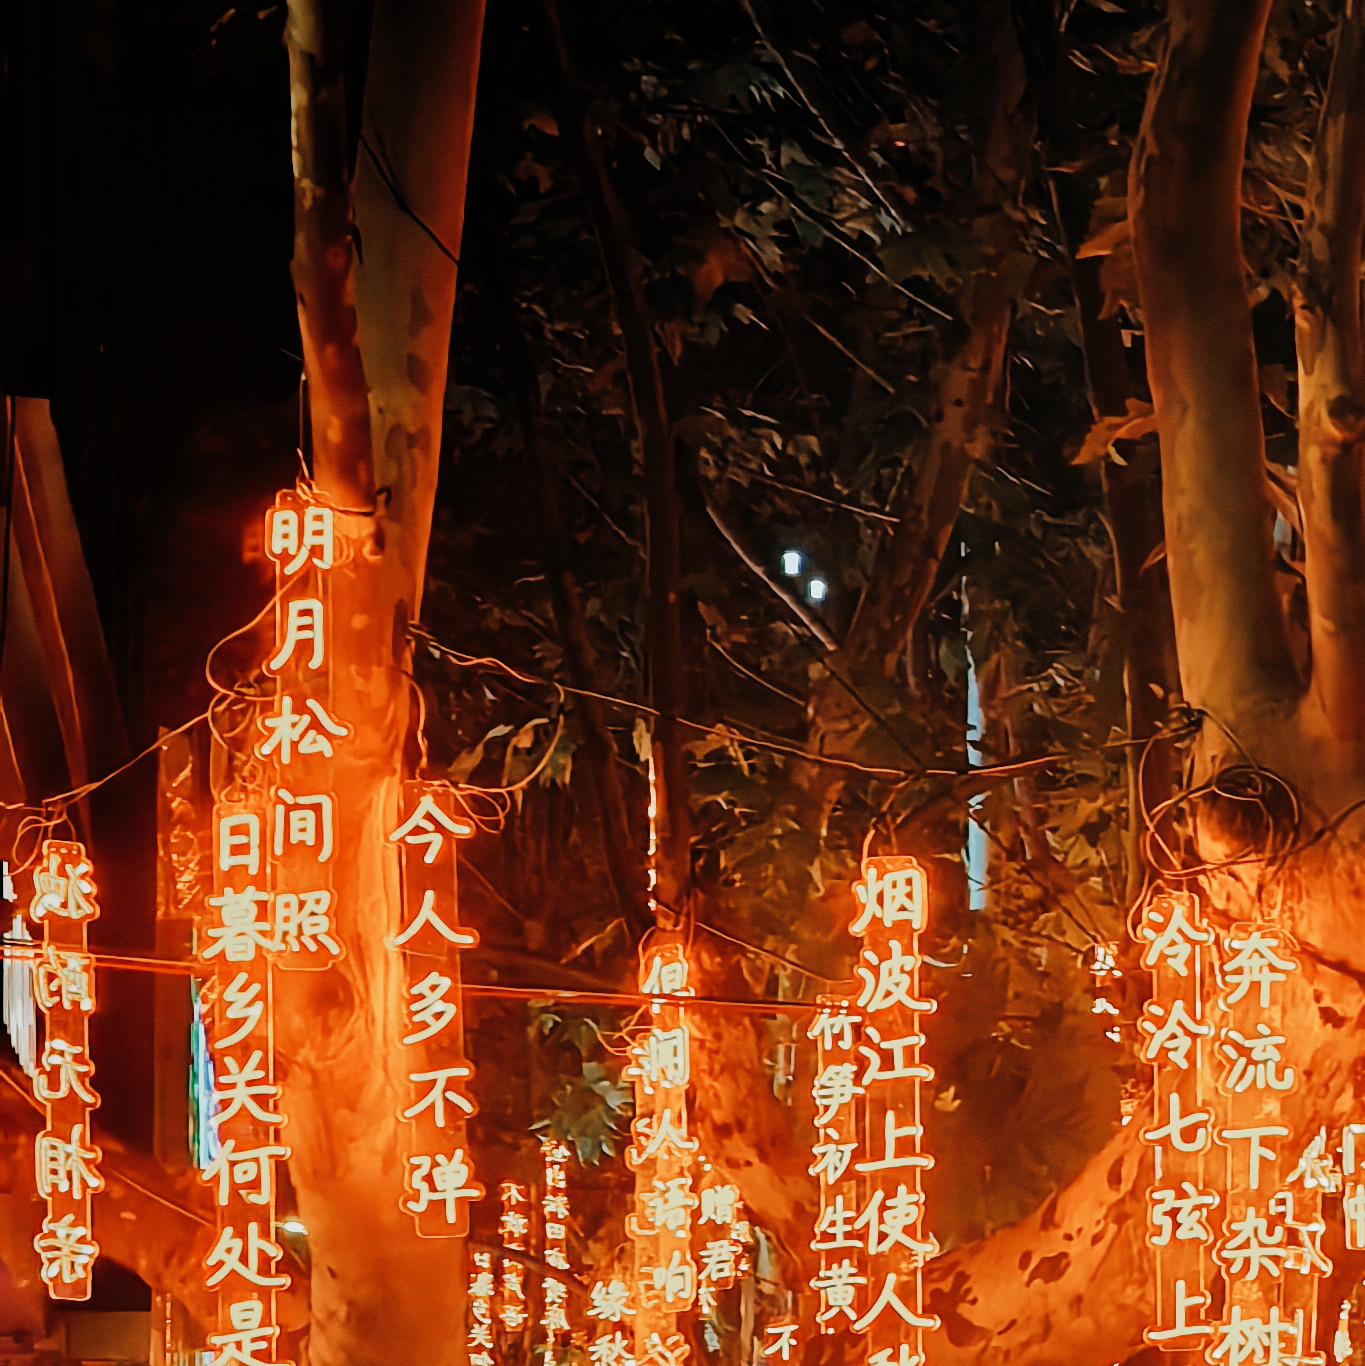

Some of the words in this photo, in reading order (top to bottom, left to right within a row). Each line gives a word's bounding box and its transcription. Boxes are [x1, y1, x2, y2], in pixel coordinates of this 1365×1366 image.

[260, 507, 348, 955] 明月松间照
[389, 793, 479, 1224] 今人多不弹
